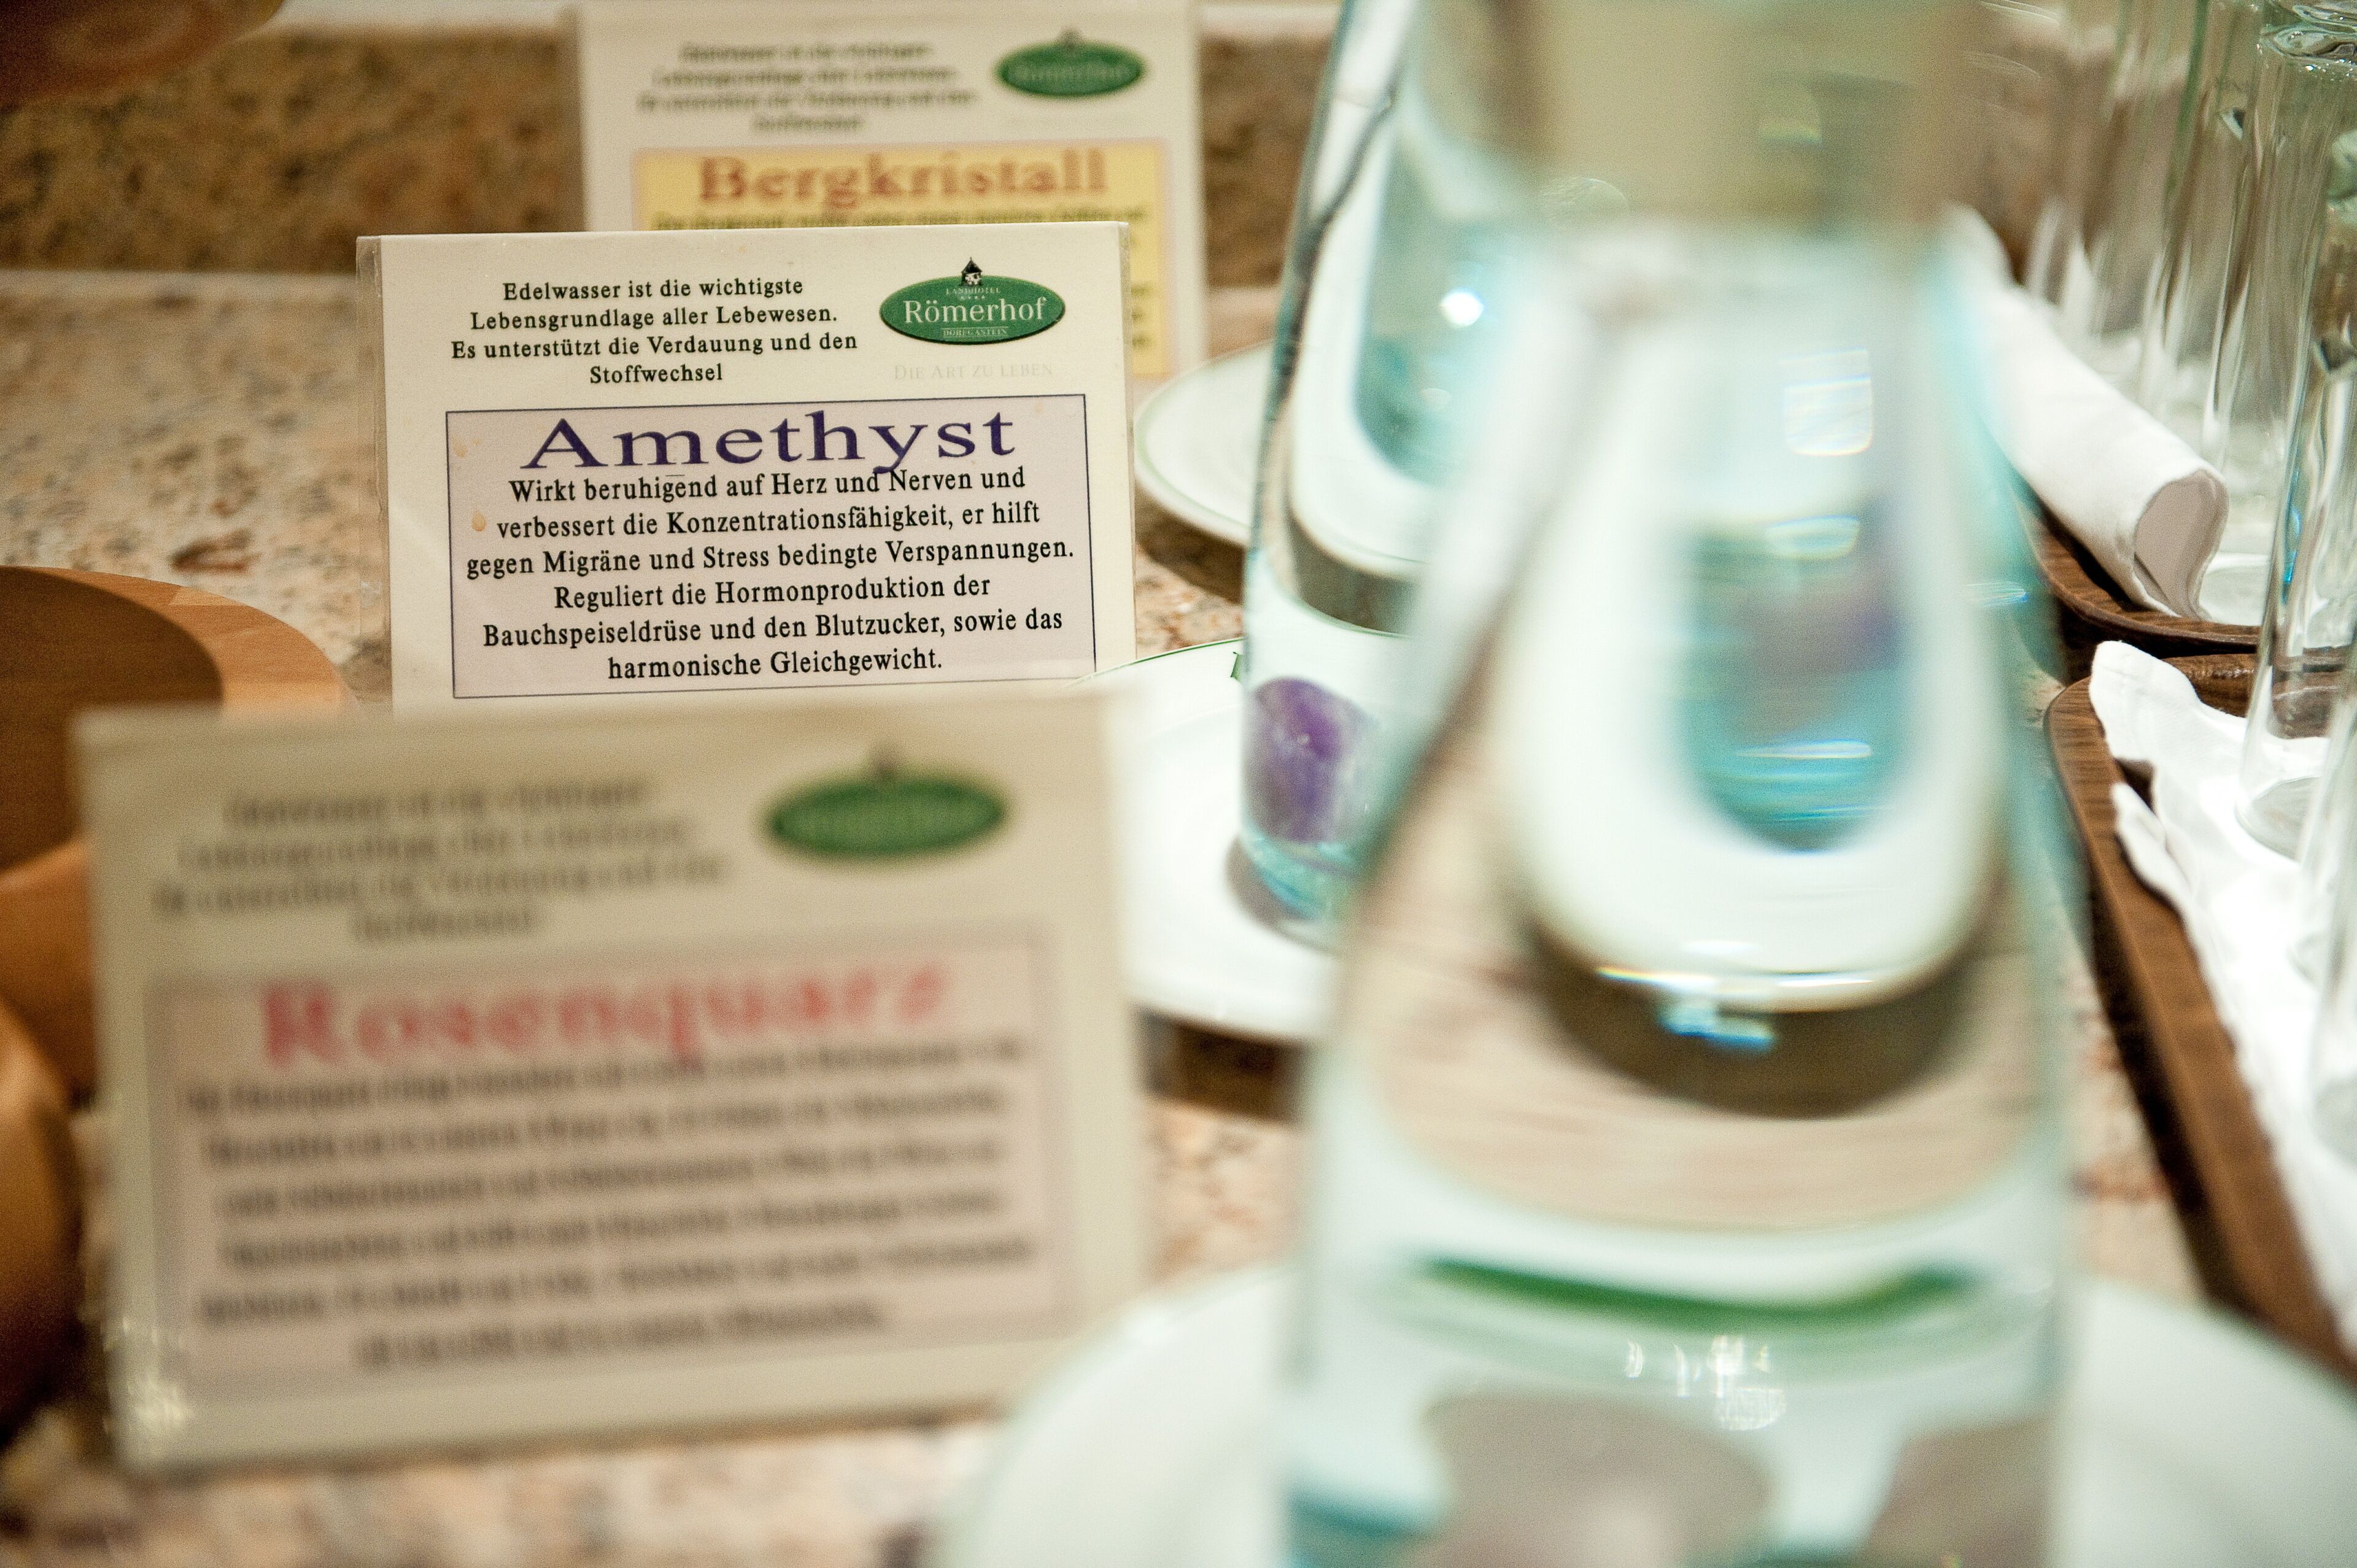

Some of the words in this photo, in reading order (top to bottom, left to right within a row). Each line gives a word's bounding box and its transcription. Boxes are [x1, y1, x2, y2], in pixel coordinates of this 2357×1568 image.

[697, 147, 1109, 210] Bergkristall
[502, 282, 621, 301] Edelwasser
[628, 282, 652, 298] ist
[660, 279, 691, 297] die
[699, 277, 803, 298] wichtigste
[470, 308, 654, 333] Lebensgrundlage
[662, 307, 708, 326] aller
[716, 305, 837, 324] Lebewesen.
[904, 296, 1047, 324] Römerhof
[451, 341, 476, 359] Es
[484, 339, 601, 358] unterstützt
[608, 337, 640, 355] die
[646, 334, 764, 355] Verdauung
[770, 332, 811, 351] und
[819, 331, 857, 350] den
[590, 363, 722, 384] Stoffwechsel
[519, 410, 1015, 474] Amethyst
[508, 479, 576, 503] Wirkt
[583, 476, 718, 503] beruhigend
[726, 473, 765, 497] auf
[770, 473, 827, 495] Herz
[834, 470, 880, 493] und
[888, 469, 973, 492] Nerven
[980, 465, 1026, 489] und
[497, 515, 616, 539] verbessert
[623, 512, 658, 535] die
[666, 503, 953, 534] Konzentrationsfähigkeit,
[962, 508, 985, 525] er
[991, 500, 1040, 524] hilft
[466, 557, 535, 581] gegen
[542, 549, 641, 577] Migräne
[649, 547, 695, 570] und
[703, 546, 769, 569] Stress
[777, 543, 877, 570] bedingte
[884, 540, 1074, 566] Verspannungen.
[554, 584, 664, 613] Reguliert
[671, 582, 706, 606] die
[714, 576, 945, 606] Hormonproduktion
[953, 573, 990, 597] der
[482, 619, 701, 649] Bauchspeiseldrüse
[710, 616, 756, 640] und
[764, 616, 807, 638] den
[815, 611, 945, 638] Blutzucker,
[954, 608, 1016, 632] sowie
[1025, 607, 1062, 630] das
[608, 652, 761, 679] harmonische
[770, 646, 942, 676] Gleichgewicht.
